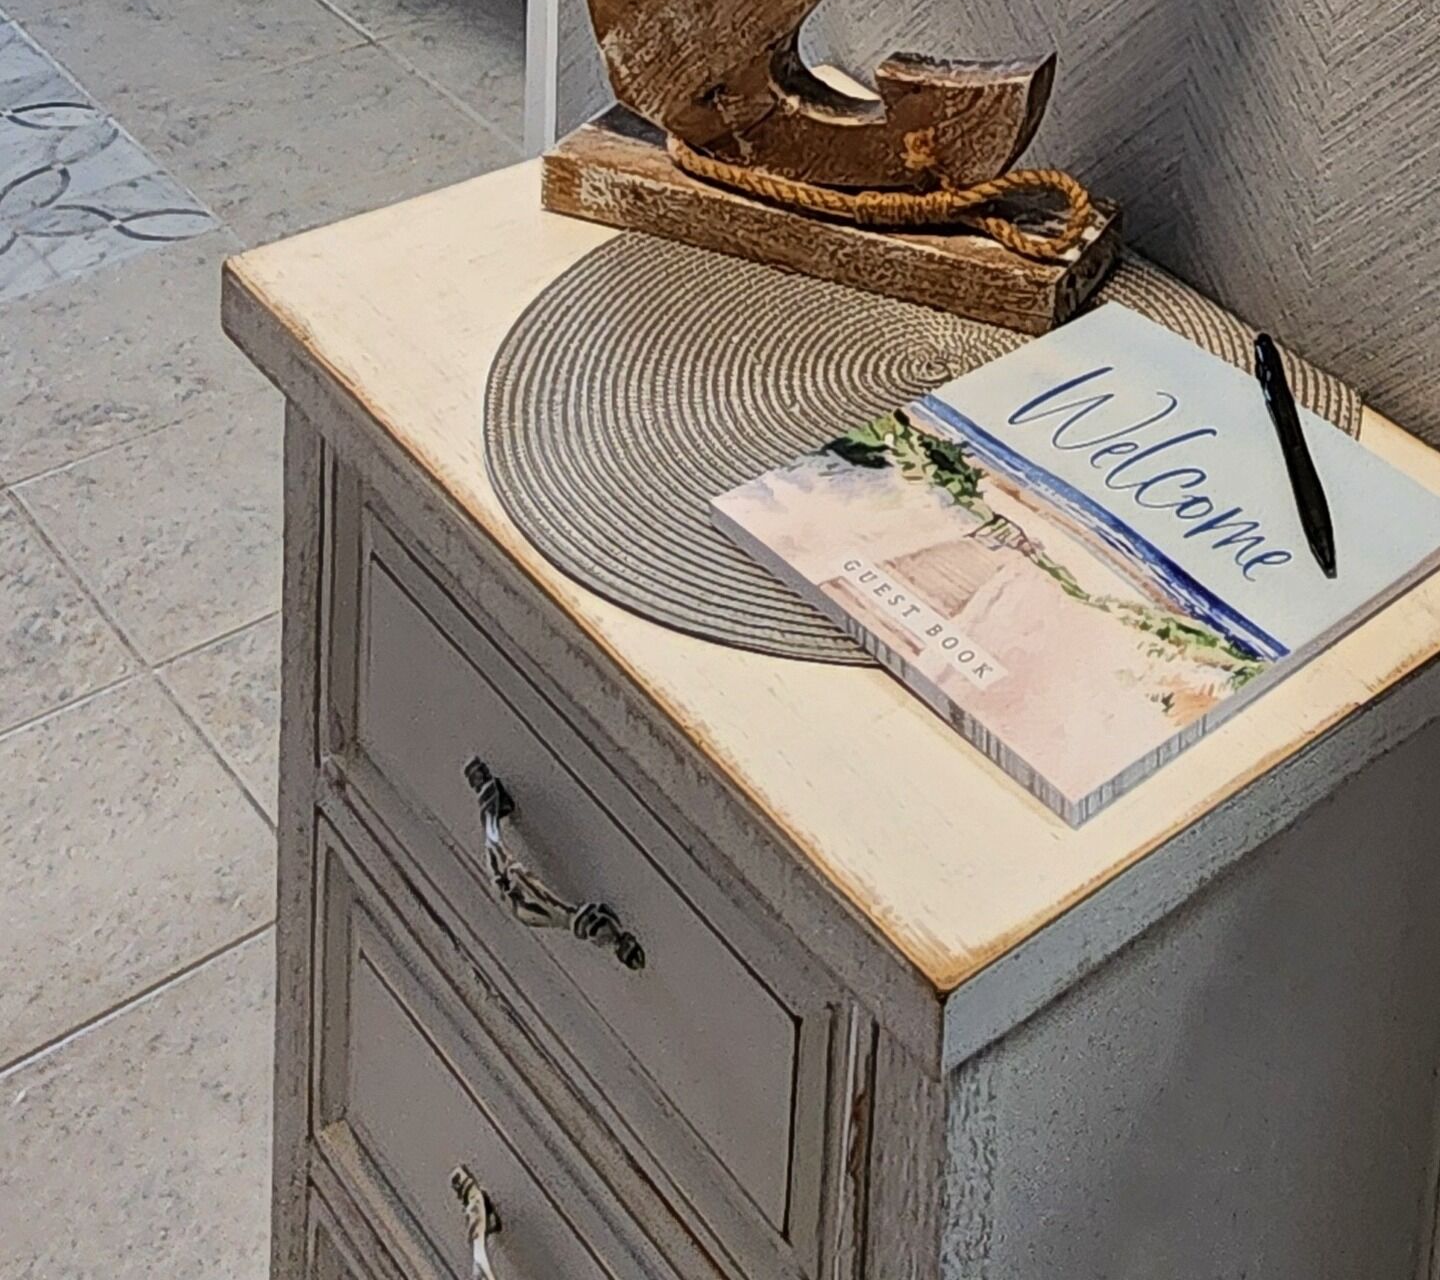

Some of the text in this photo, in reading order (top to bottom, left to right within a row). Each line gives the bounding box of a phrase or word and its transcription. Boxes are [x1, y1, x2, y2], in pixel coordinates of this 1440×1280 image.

[1008, 366, 1293, 582] Welcome
[843, 559, 994, 680] GUEST BOOK
